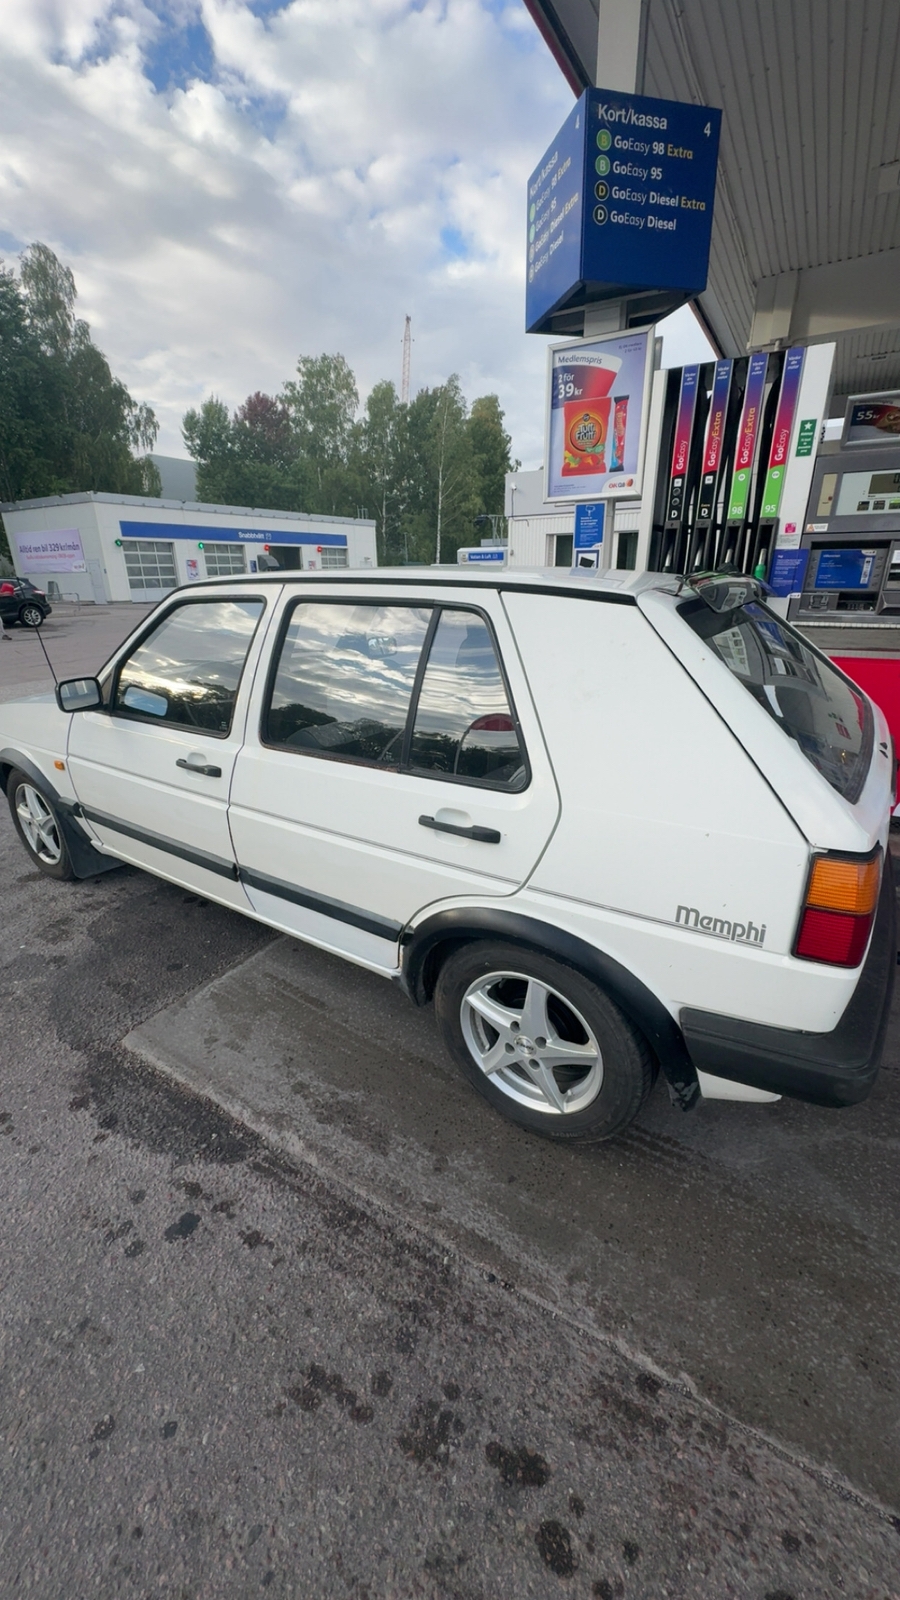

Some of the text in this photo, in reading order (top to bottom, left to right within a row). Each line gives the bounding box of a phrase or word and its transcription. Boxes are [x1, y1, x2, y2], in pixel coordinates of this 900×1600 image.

[598, 104, 668, 130] Kort/kassa
[704, 122, 711, 137] 4
[614, 136, 650, 156] GoEasy
[652, 142, 665, 154] 98
[667, 144, 693, 159] Extra
[613, 161, 648, 181] GoEasy
[650, 167, 662, 180] 95
[612, 186, 647, 205] GoEasy
[649, 192, 679, 207] Diesel
[681, 196, 706, 210] Extra
[610, 210, 646, 229] GoEasy
[647, 216, 677, 230] Diesel
[558, 355, 602, 365] Medlemspris
[558, 373, 574, 383] 2 för
[558, 383, 583, 399] 39 kr
[856, 410, 873, 420] 55
[774, 429, 789, 460] GoEasy
[676, 440, 688, 470] GoEasy
[671, 510, 678, 518] D
[765, 505, 776, 513] 95
[675, 904, 767, 943] Memphi
